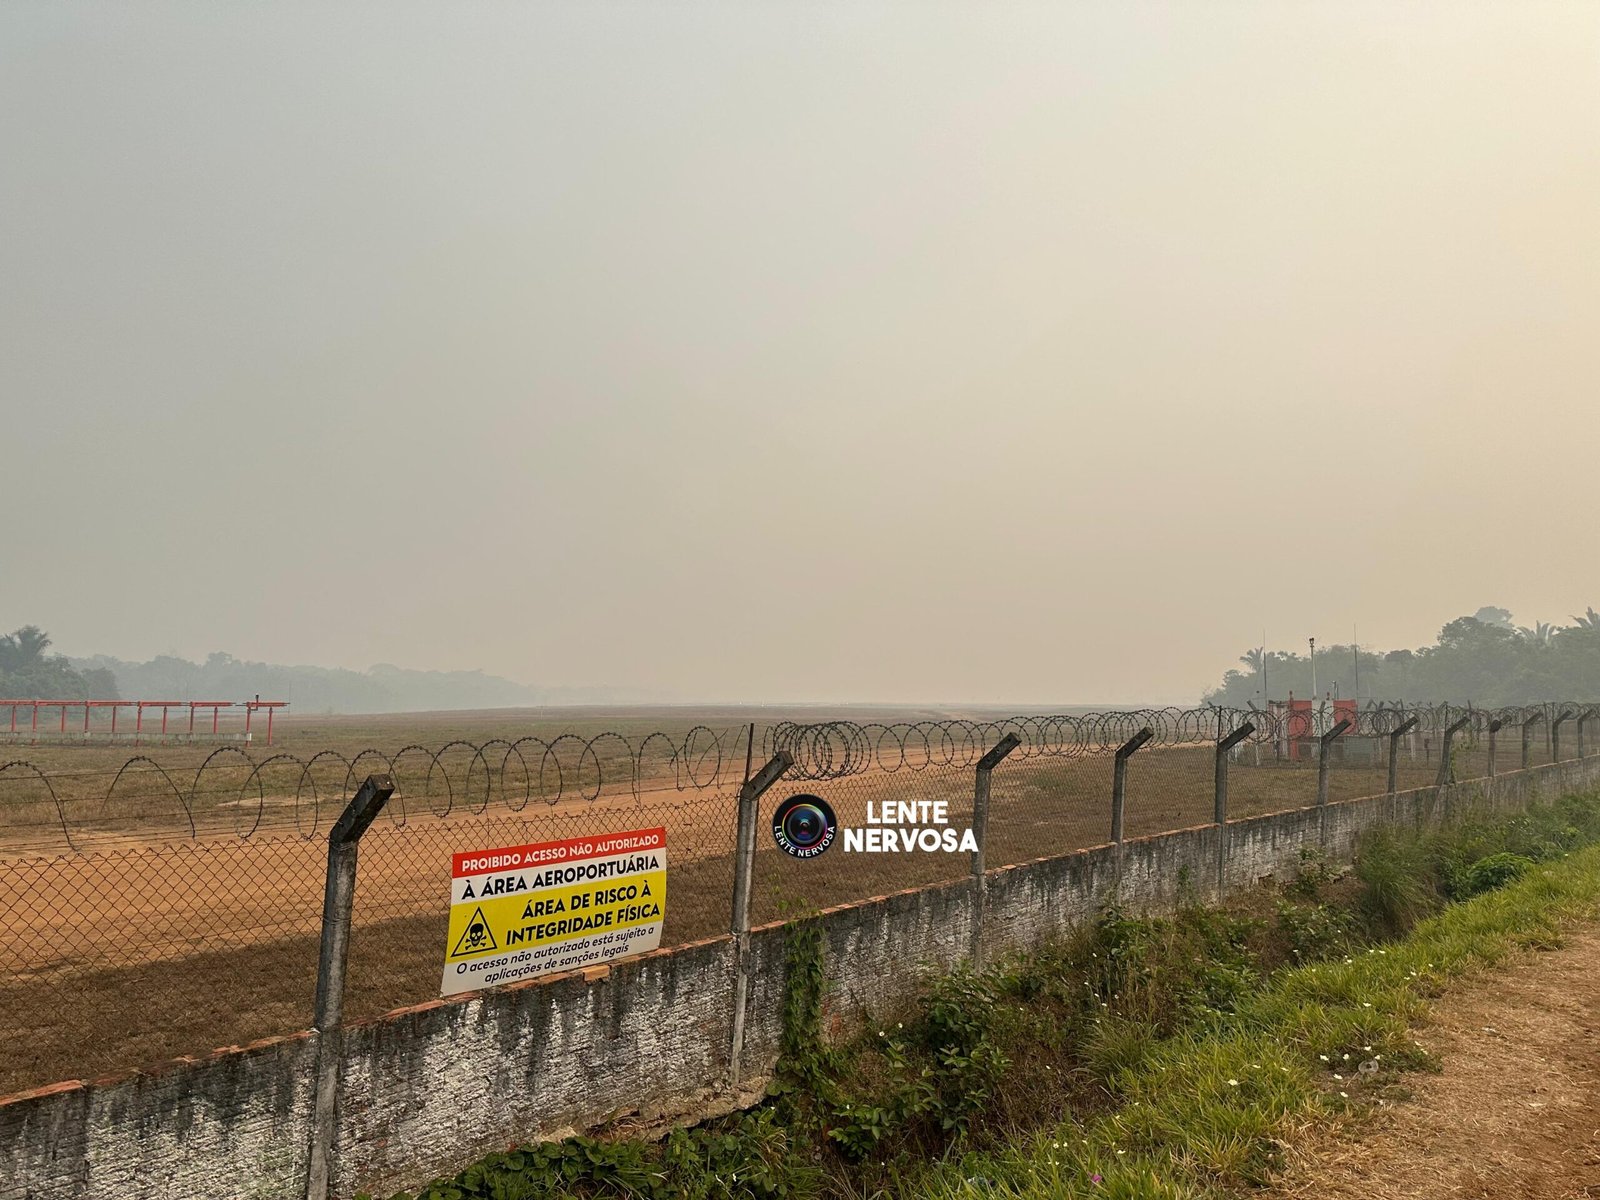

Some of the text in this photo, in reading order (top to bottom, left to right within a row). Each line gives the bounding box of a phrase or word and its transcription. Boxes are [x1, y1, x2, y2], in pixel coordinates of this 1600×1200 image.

[462, 834, 659, 872] PROIBIDO ACESSO NÃO AUTORIZADO
[462, 855, 659, 900] À ÁREA AEROPORTUÁRIA
[522, 880, 651, 919] ÁREA DE RISCO À
[506, 903, 660, 945] INTEGRIDADE FÍSICA
[456, 926, 654, 975] O acesso não autorizado está sujeito a
[485, 943, 629, 984] aplicações de sanções legais
